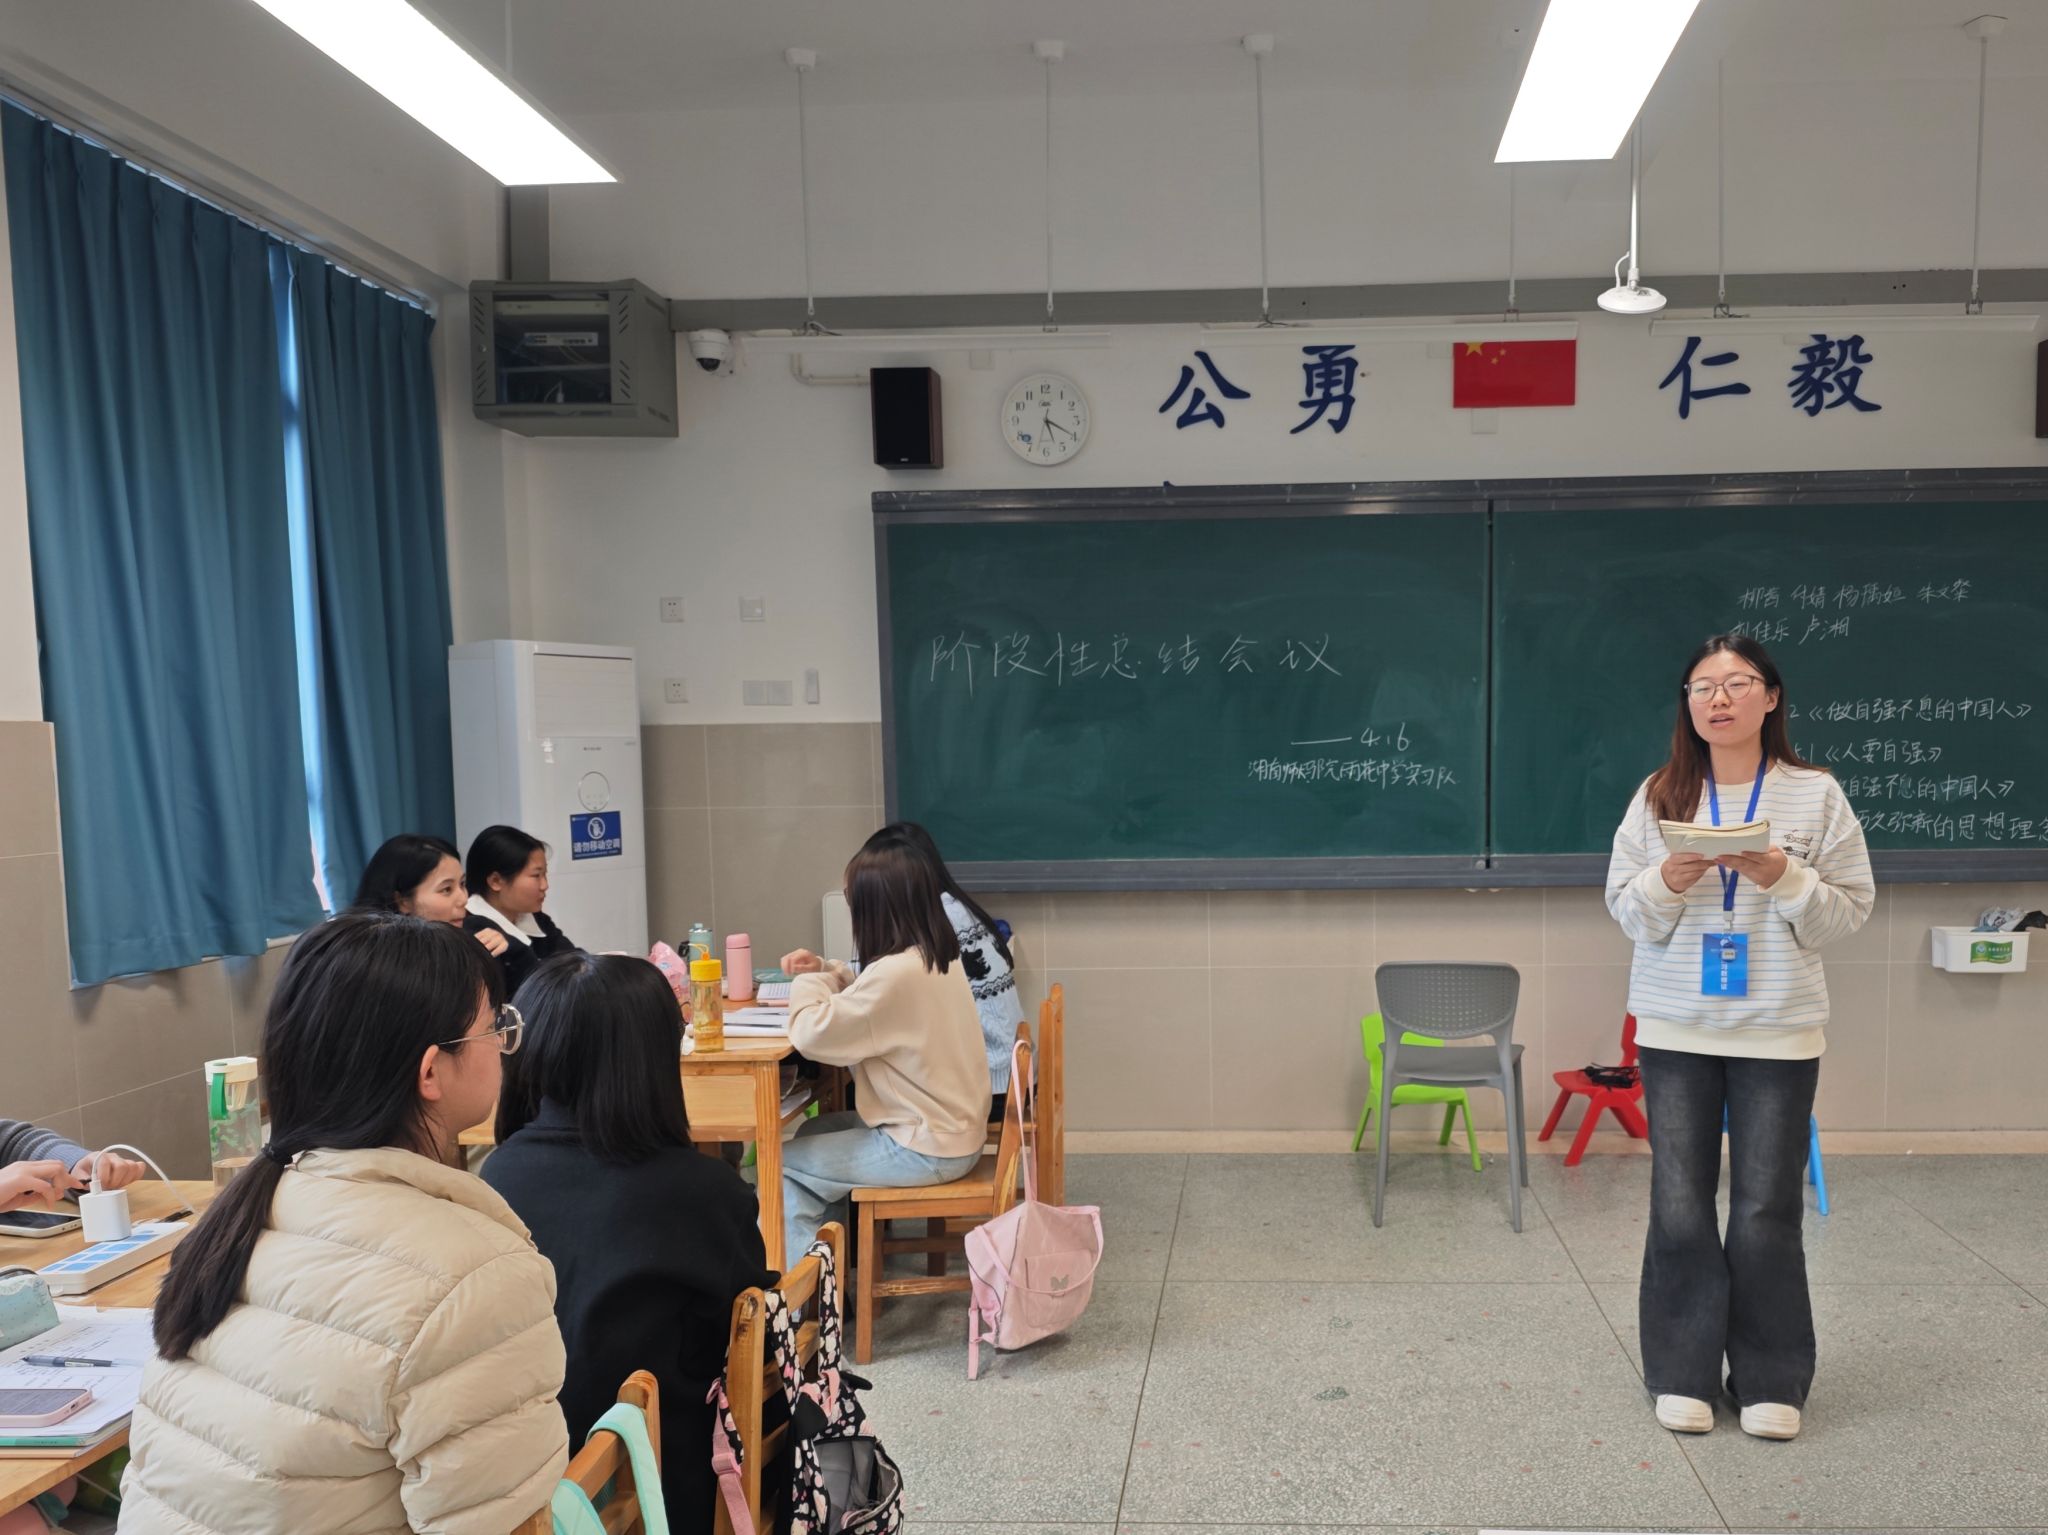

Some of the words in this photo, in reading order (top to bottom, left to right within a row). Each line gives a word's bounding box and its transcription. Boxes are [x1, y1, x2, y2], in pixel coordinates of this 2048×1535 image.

[1040, 383, 1051, 394] 12
[1159, 344, 1357, 435] 公勇
[1659, 333, 1882, 419] 仁毅
[1015, 401, 1025, 412] 10
[1067, 401, 1076, 411] 2
[1011, 415, 1020, 426] 9
[1073, 415, 1081, 426] 3
[1042, 447, 1051, 458] 6
[1059, 442, 1067, 453] 5
[930, 630, 1342, 696] 阶段性总结会议
[1808, 694, 2032, 722] 《做自强不息的中国人》
[1825, 738, 1942, 765] 《人要自强》
